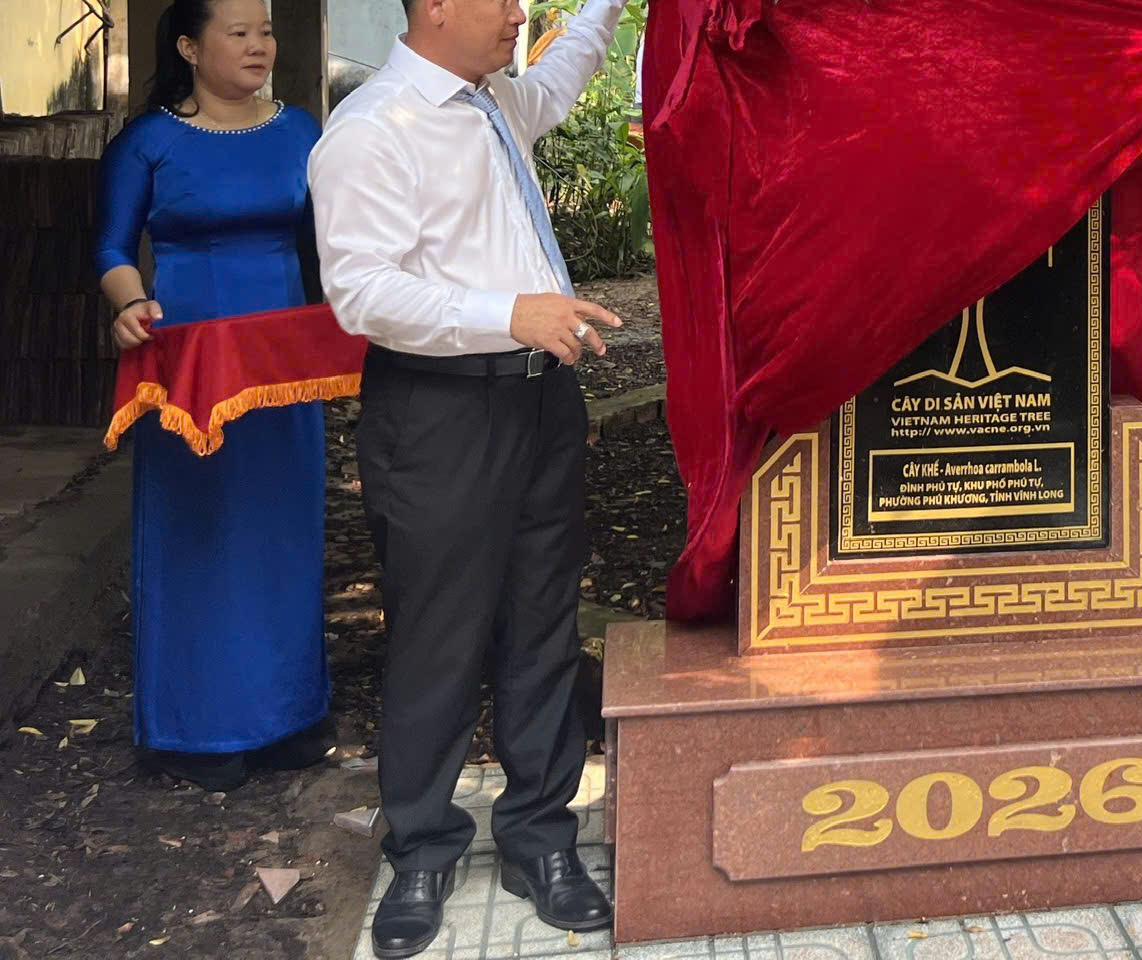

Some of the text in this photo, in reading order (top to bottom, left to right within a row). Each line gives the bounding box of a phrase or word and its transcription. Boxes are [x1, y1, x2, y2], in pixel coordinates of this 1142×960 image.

[892, 392, 1051, 412] CÂY DI SẢN VIỆT NAM
[891, 411, 1051, 426] VIETNAM HERITAGE TREE
[891, 424, 1050, 438] http:// www.vacne.org.vn
[945, 461, 983, 476] Averrhoa
[985, 458, 1032, 474] carrambola
[1034, 458, 1042, 472] L.
[964, 480, 984, 491] KHU
[986, 477, 1006, 490] PHỐ
[879, 495, 921, 508] PHƯỜNG
[944, 492, 988, 505] KHƯƠNG,
[1039, 489, 1063, 499] LONG
